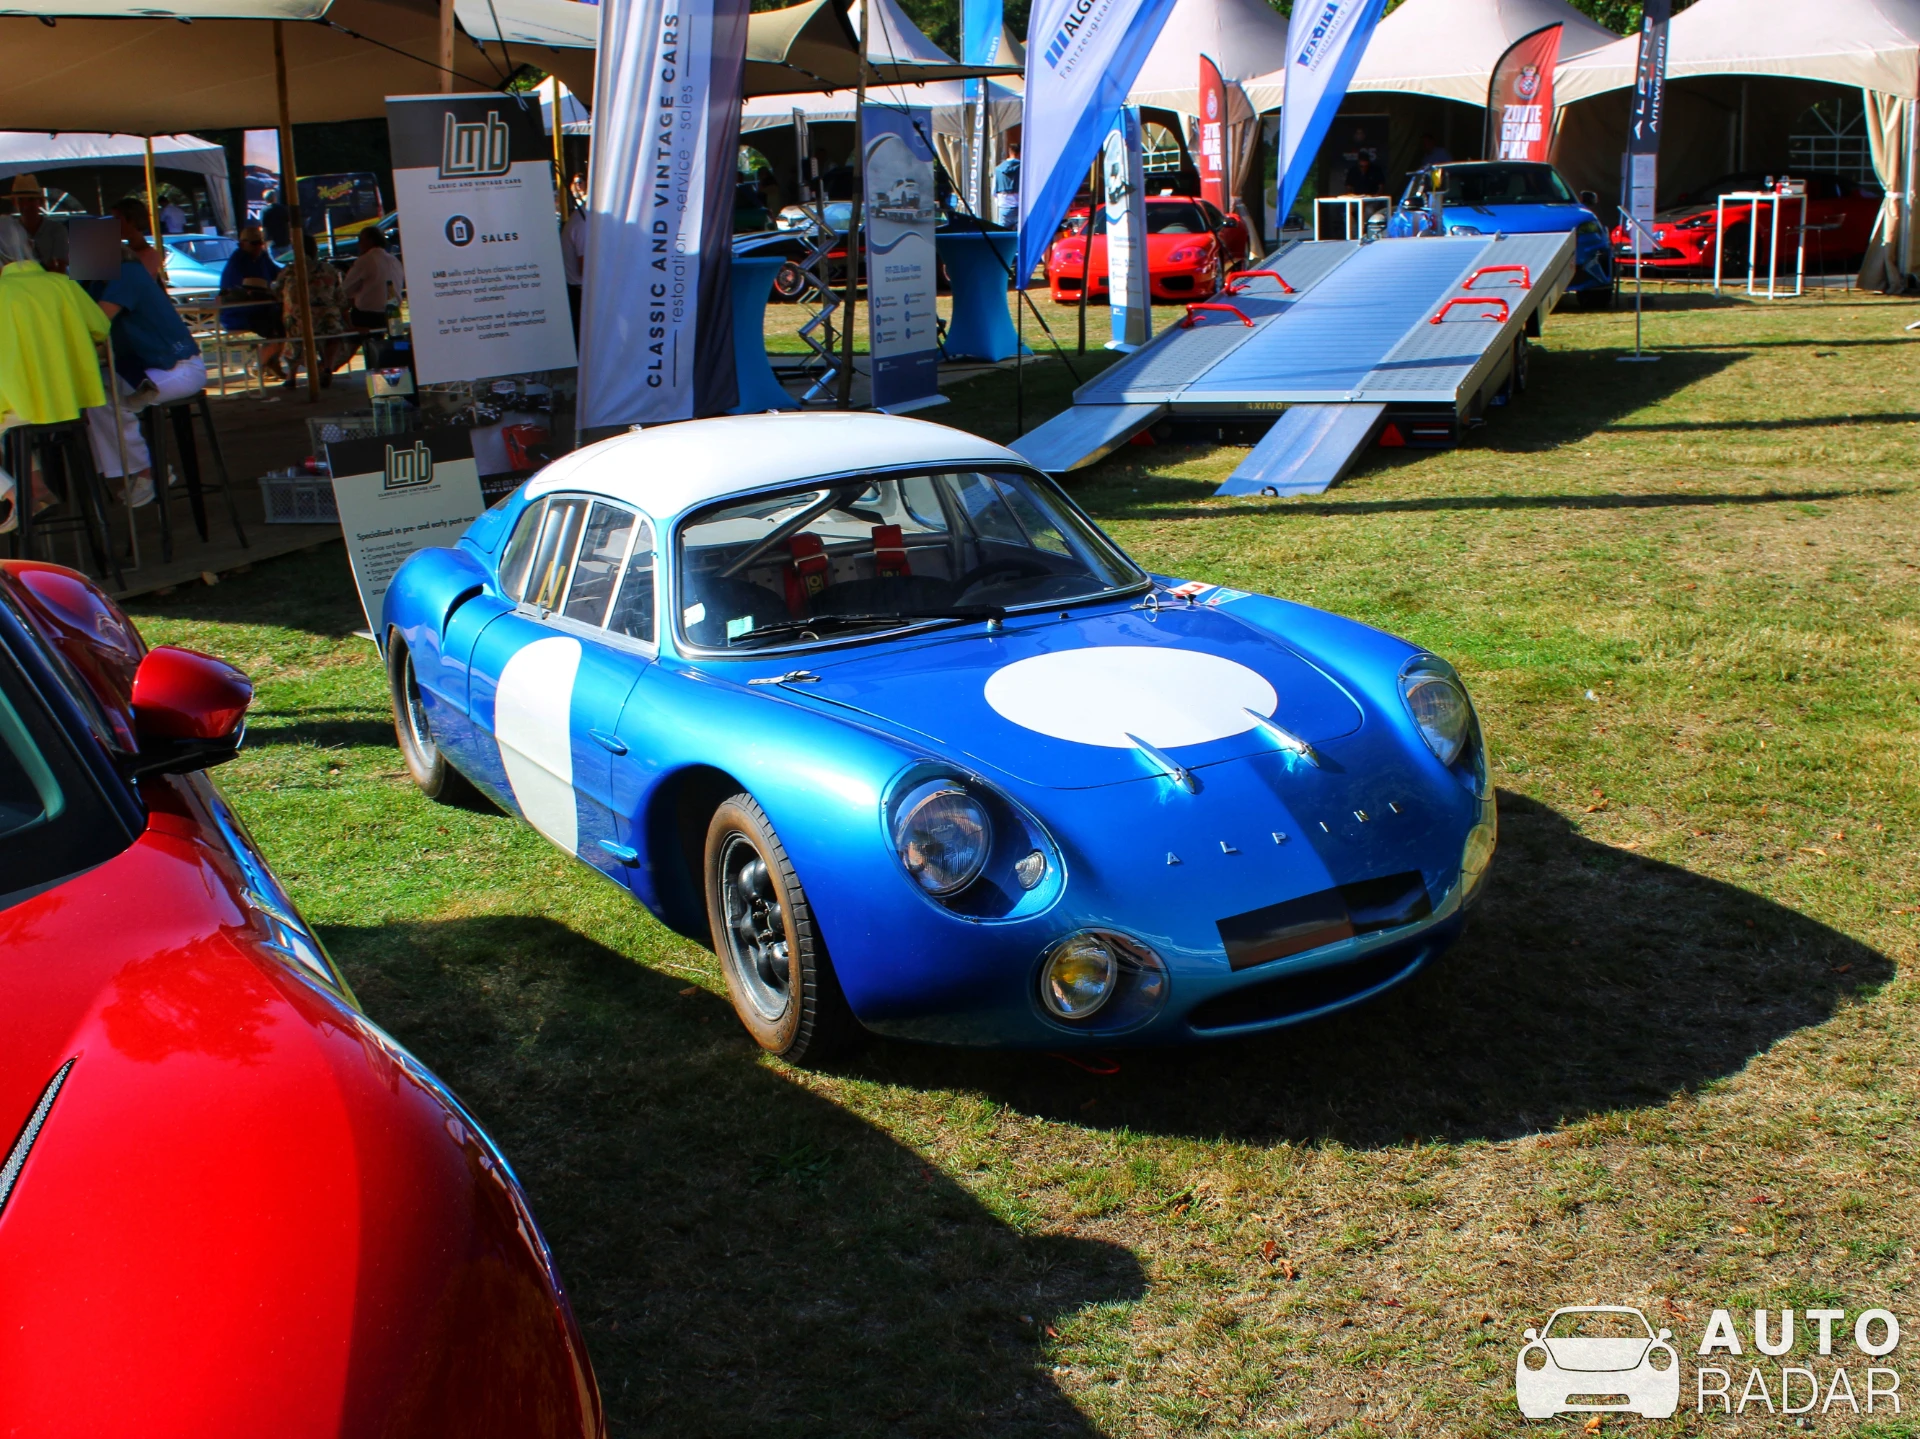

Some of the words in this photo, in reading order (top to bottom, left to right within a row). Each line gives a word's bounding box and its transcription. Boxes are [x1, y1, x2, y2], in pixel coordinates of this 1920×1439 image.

[660, 14, 680, 83] CARS
[1634, 16, 1653, 140] ALPINE
[1649, 36, 1665, 133] Antwerpen
[682, 85, 694, 131] sales
[1503, 104, 1543, 123] ZOUTE
[1502, 123, 1543, 141] GRAND
[654, 95, 675, 208] VINTAGE
[1500, 141, 1530, 159] PRIX
[677, 150, 690, 213] service
[481, 232, 519, 243] SALES
[651, 220, 669, 272] AND
[432, 270, 447, 278] LMB
[463, 267, 476, 275] and
[477, 267, 492, 275] buys
[493, 264, 513, 273] classic
[464, 277, 471, 285] of
[517, 271, 540, 280] provide
[672, 236, 687, 323] restoration
[435, 288, 472, 297] consultancy
[488, 284, 519, 292] valuations
[452, 325, 461, 333] for
[476, 322, 492, 331] local
[508, 316, 547, 327] international
[460, 315, 493, 323] showroom
[506, 309, 530, 318] display
[531, 309, 545, 317] your
[647, 283, 667, 388] CLASSIC
[357, 527, 394, 541] Specialized
[403, 526, 416, 535] pre-
[417, 521, 430, 530] and
[431, 519, 447, 528] early
[449, 517, 462, 526] post
